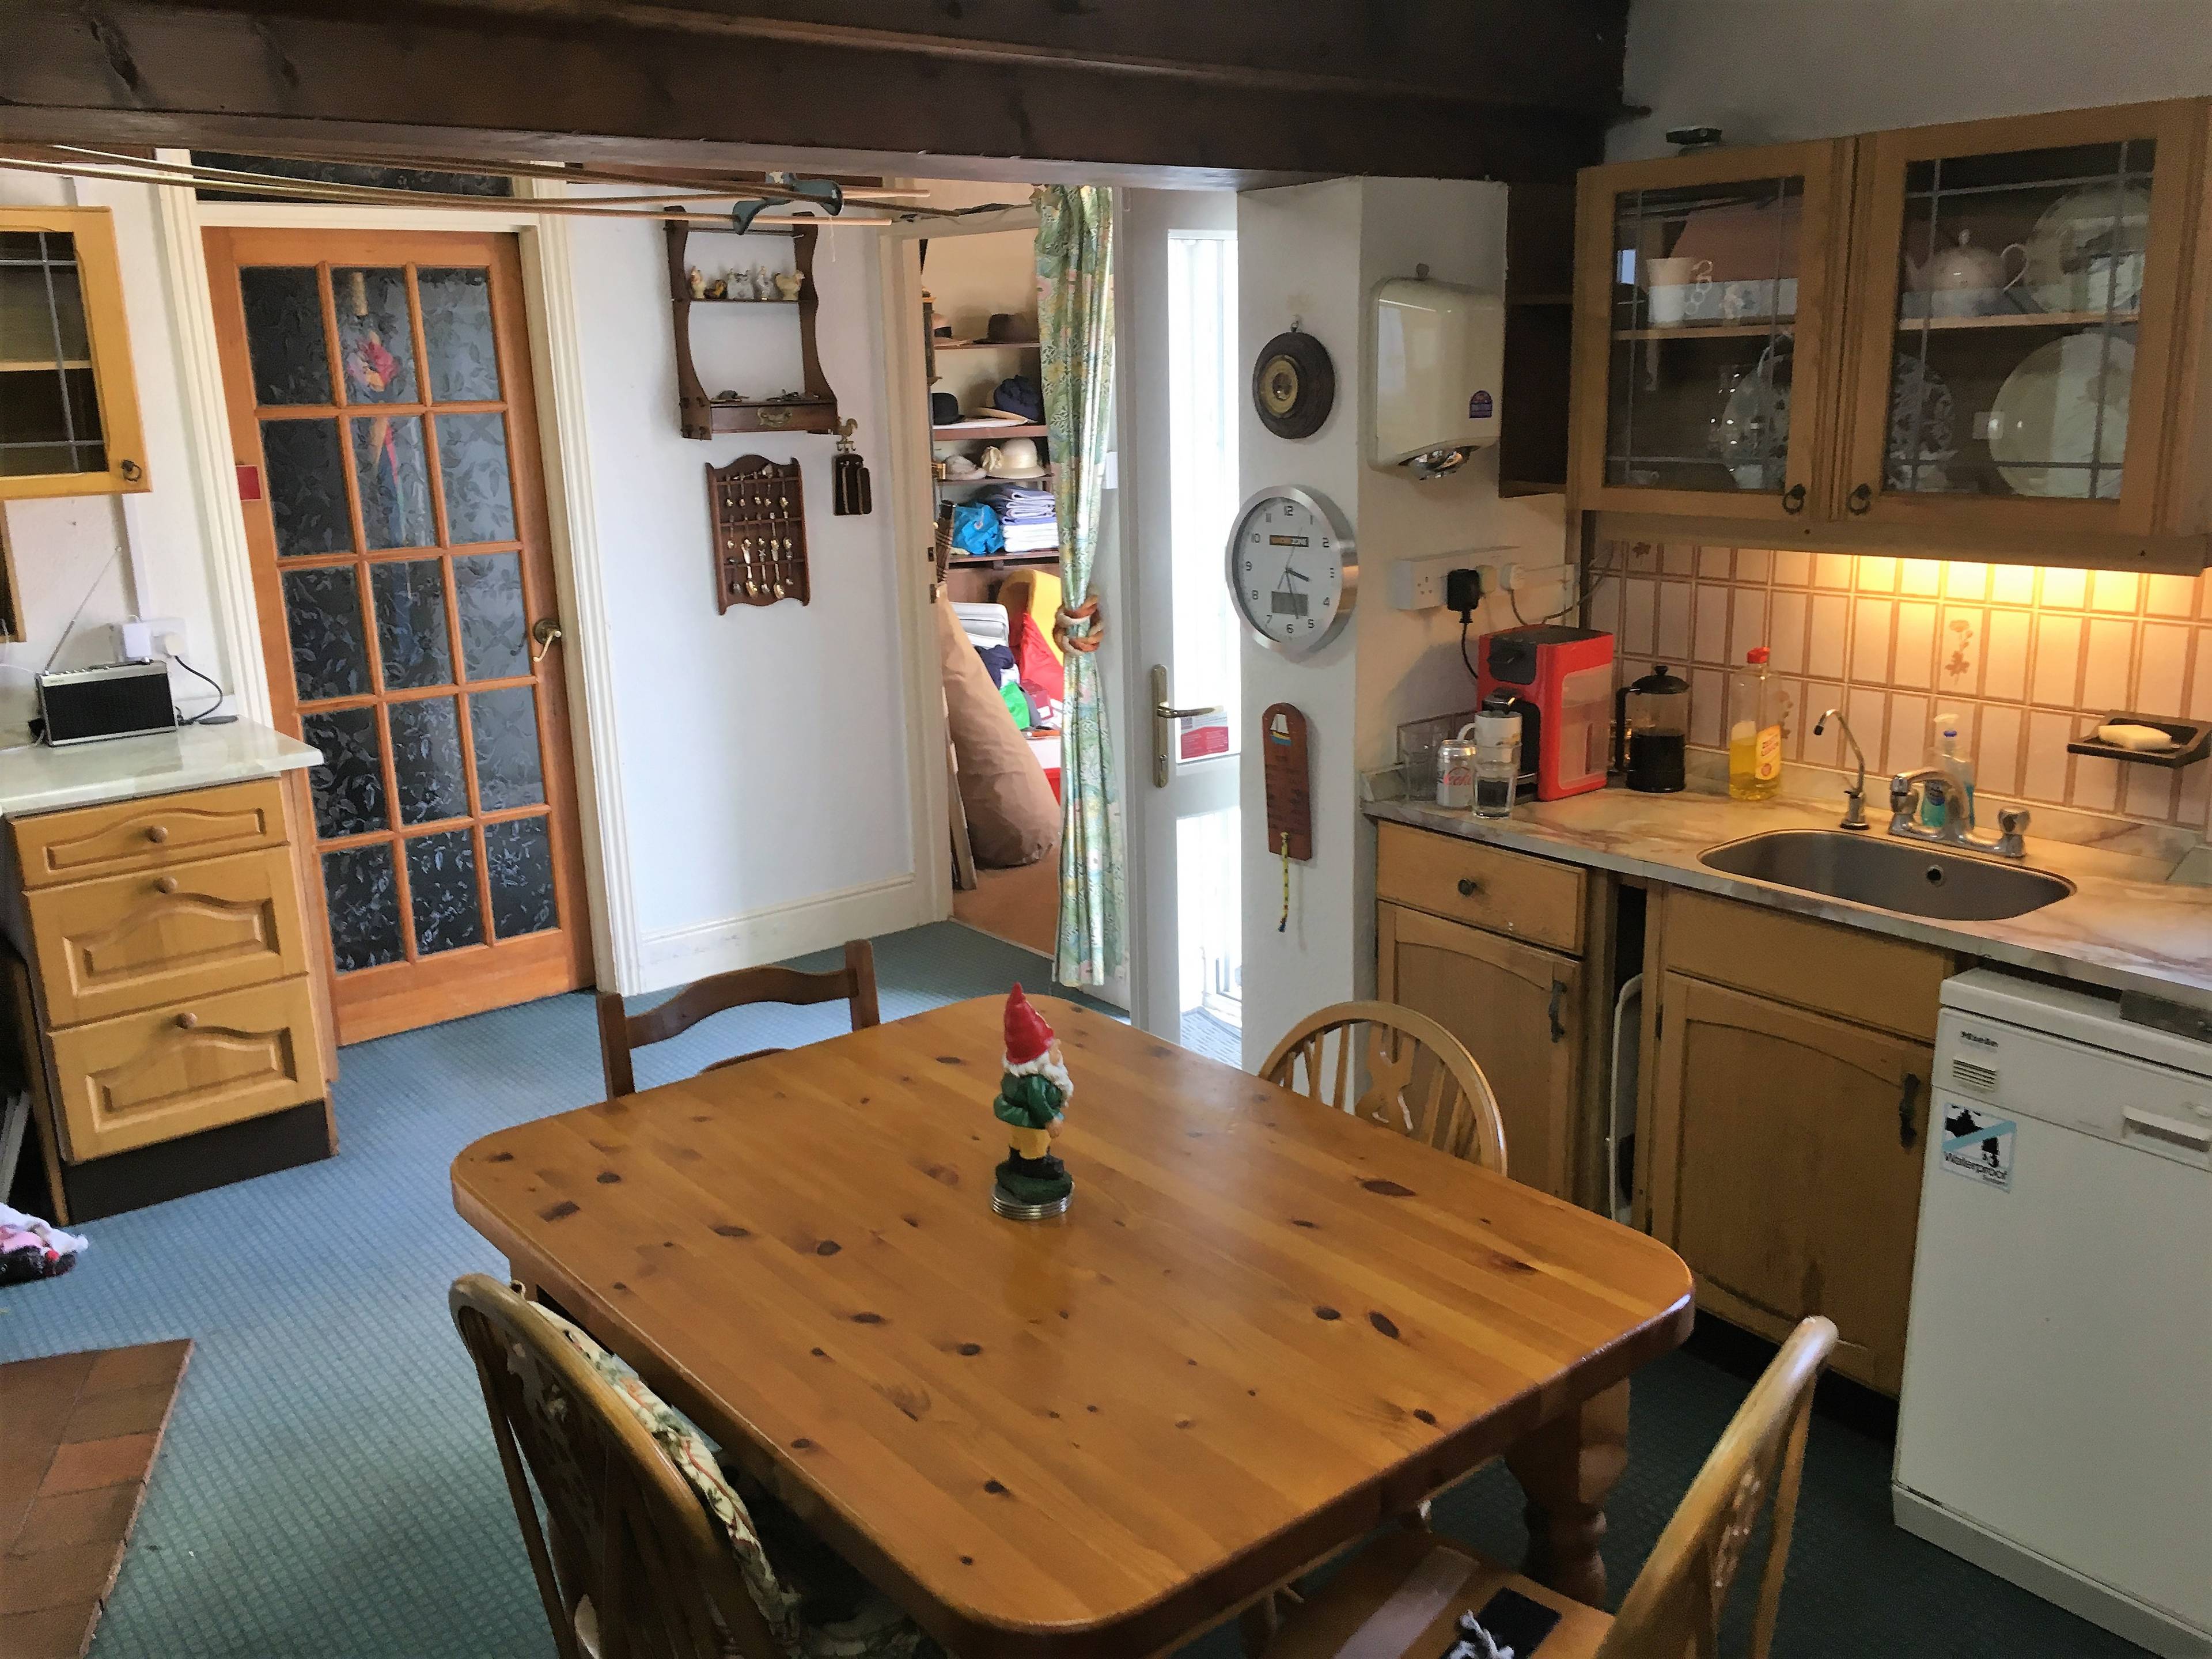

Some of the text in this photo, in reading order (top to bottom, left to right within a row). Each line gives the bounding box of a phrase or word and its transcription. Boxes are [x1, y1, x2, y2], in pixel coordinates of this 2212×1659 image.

[1284, 505, 1293, 516] 12
[1251, 533, 1261, 543] 10
[1322, 537, 1330, 548] 2
[1245, 560, 1253, 571] 9
[1252, 589, 1259, 600] 8
[1323, 597, 1330, 607] 4
[1266, 614, 1272, 624] 7
[1308, 618, 1316, 628] 5
[1286, 623, 1294, 634] 6
